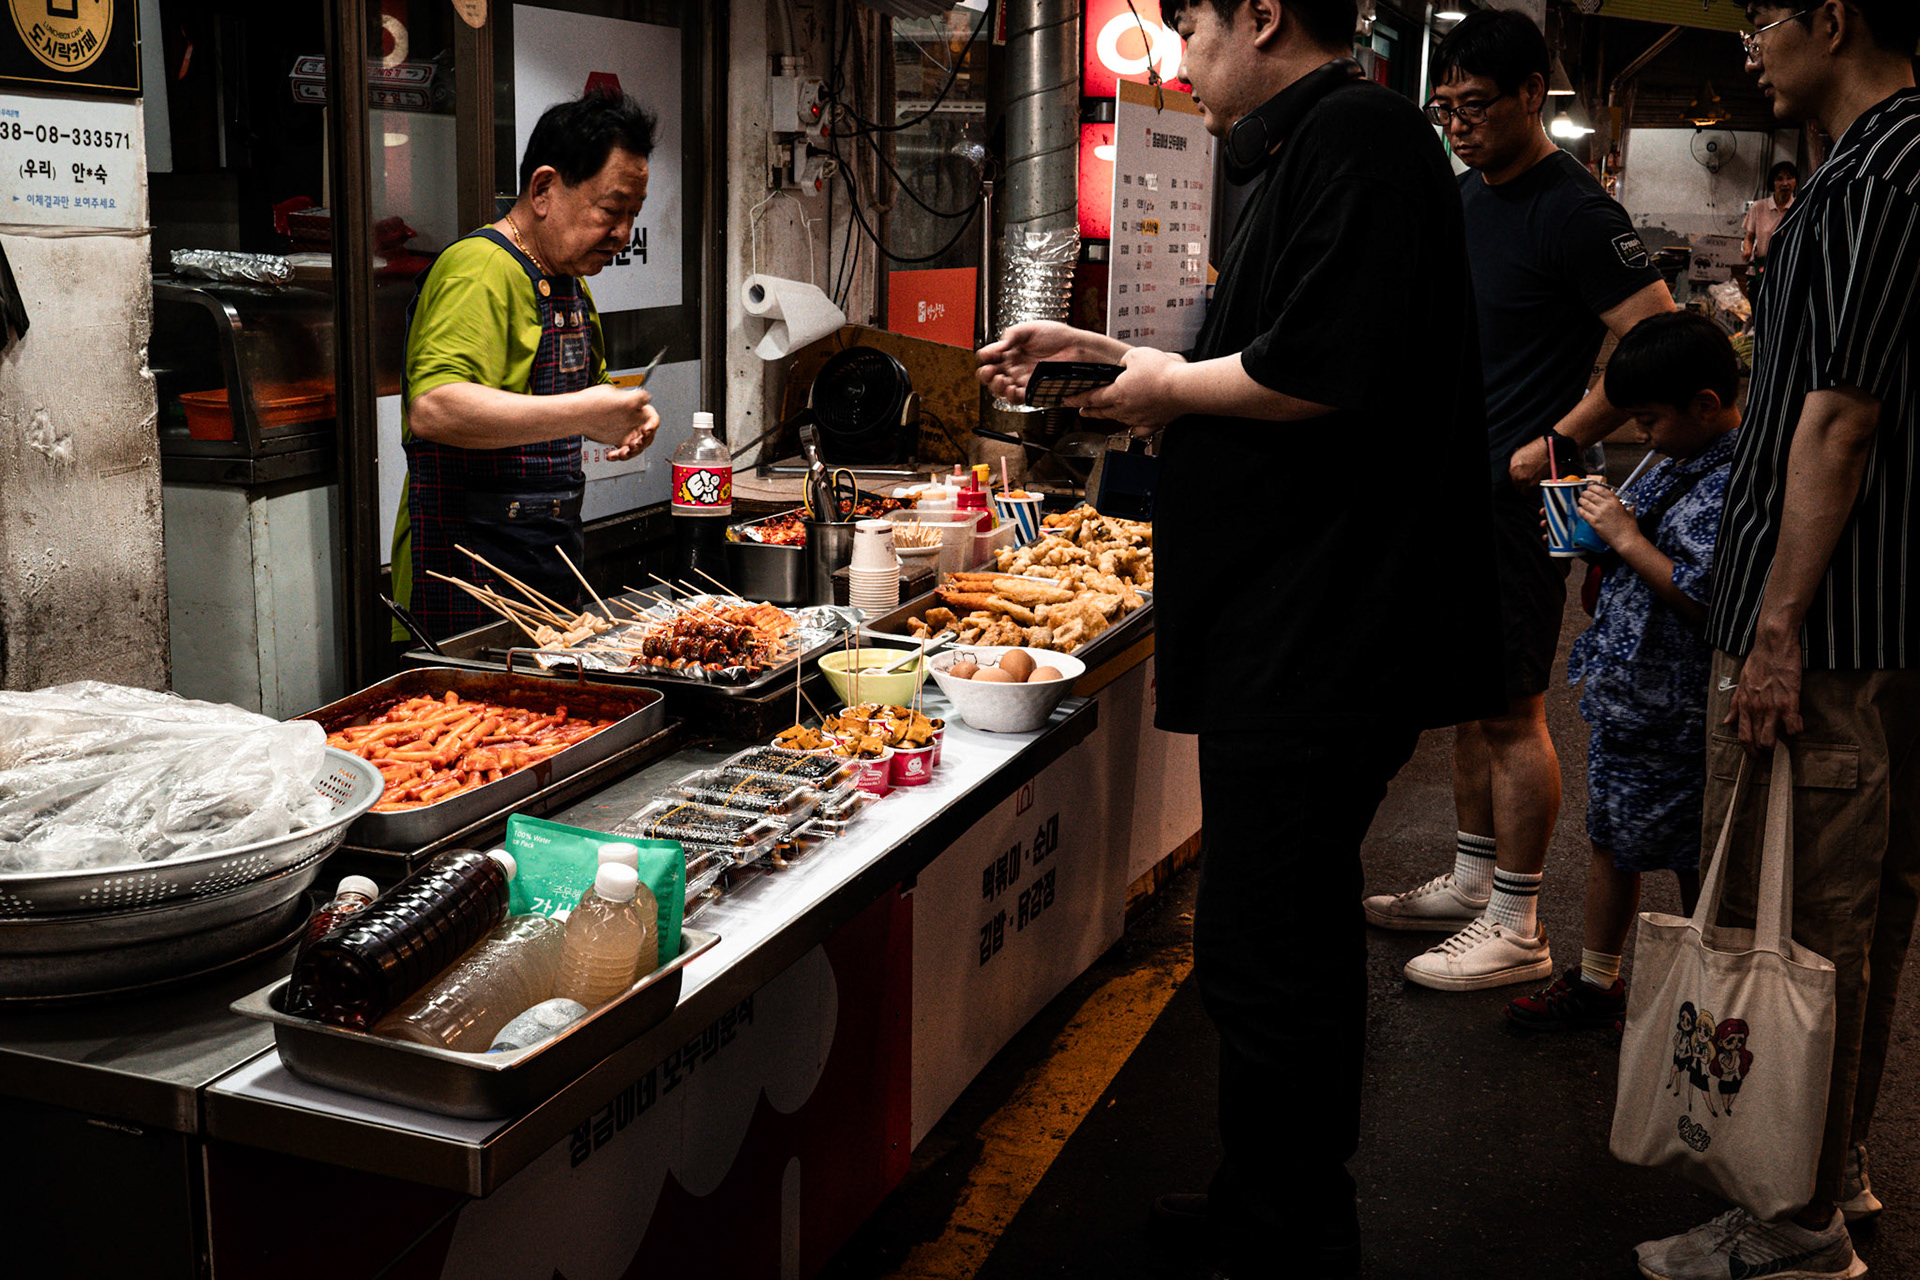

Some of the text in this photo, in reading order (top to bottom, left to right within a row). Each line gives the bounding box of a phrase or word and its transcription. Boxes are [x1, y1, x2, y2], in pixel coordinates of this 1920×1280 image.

[29, 23, 98, 62] 도시락카페
[71, 25, 84, 39] CAFE
[0, 121, 130, 149] 38-08-333571
[20, 159, 56, 180] (우리)
[27, 194, 116, 209] 이체결과만 보여주세요
[514, 830, 551, 845] 100% Water
[520, 840, 535, 849] Pack
[983, 812, 1059, 902] 떡볶이 순대
[980, 866, 1056, 967] 김밥 닭강정
